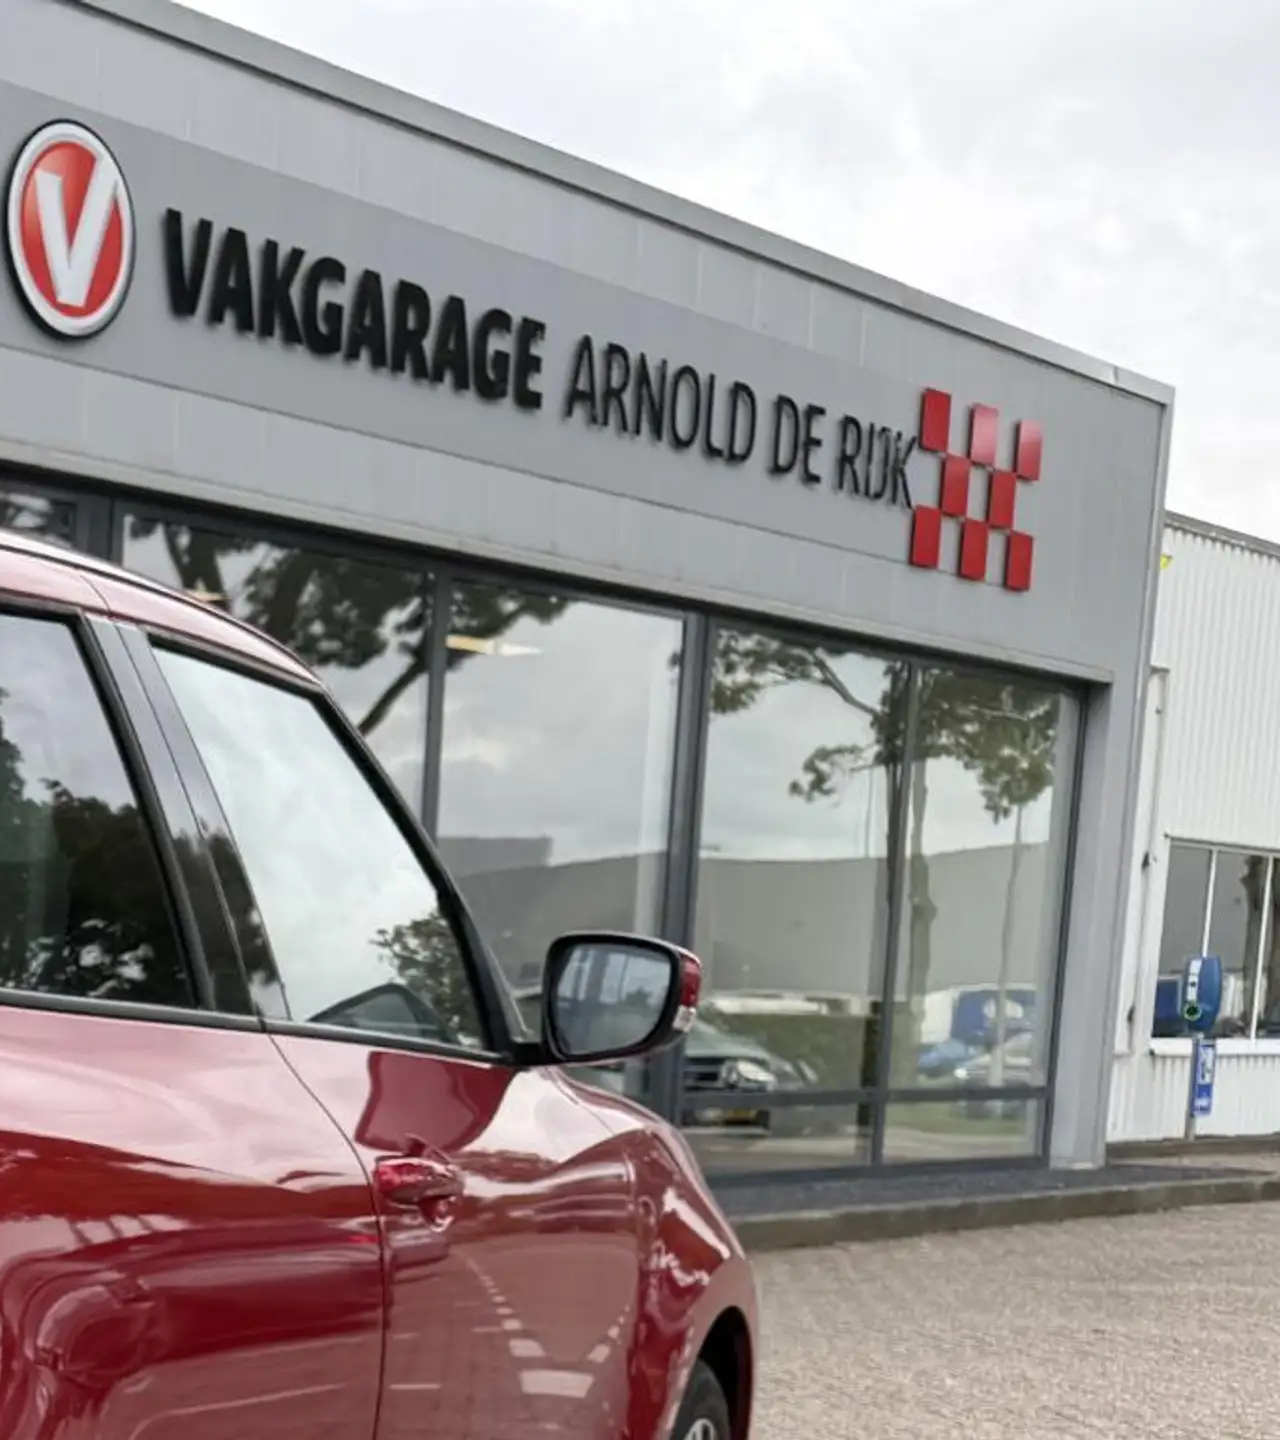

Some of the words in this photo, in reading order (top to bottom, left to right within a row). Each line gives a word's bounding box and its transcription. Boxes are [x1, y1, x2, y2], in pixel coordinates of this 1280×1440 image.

[163, 207, 547, 411] VAKGARAGE
[565, 334, 757, 465] ARNOLD
[769, 393, 827, 485] DE
[838, 413, 918, 511] RIJK
